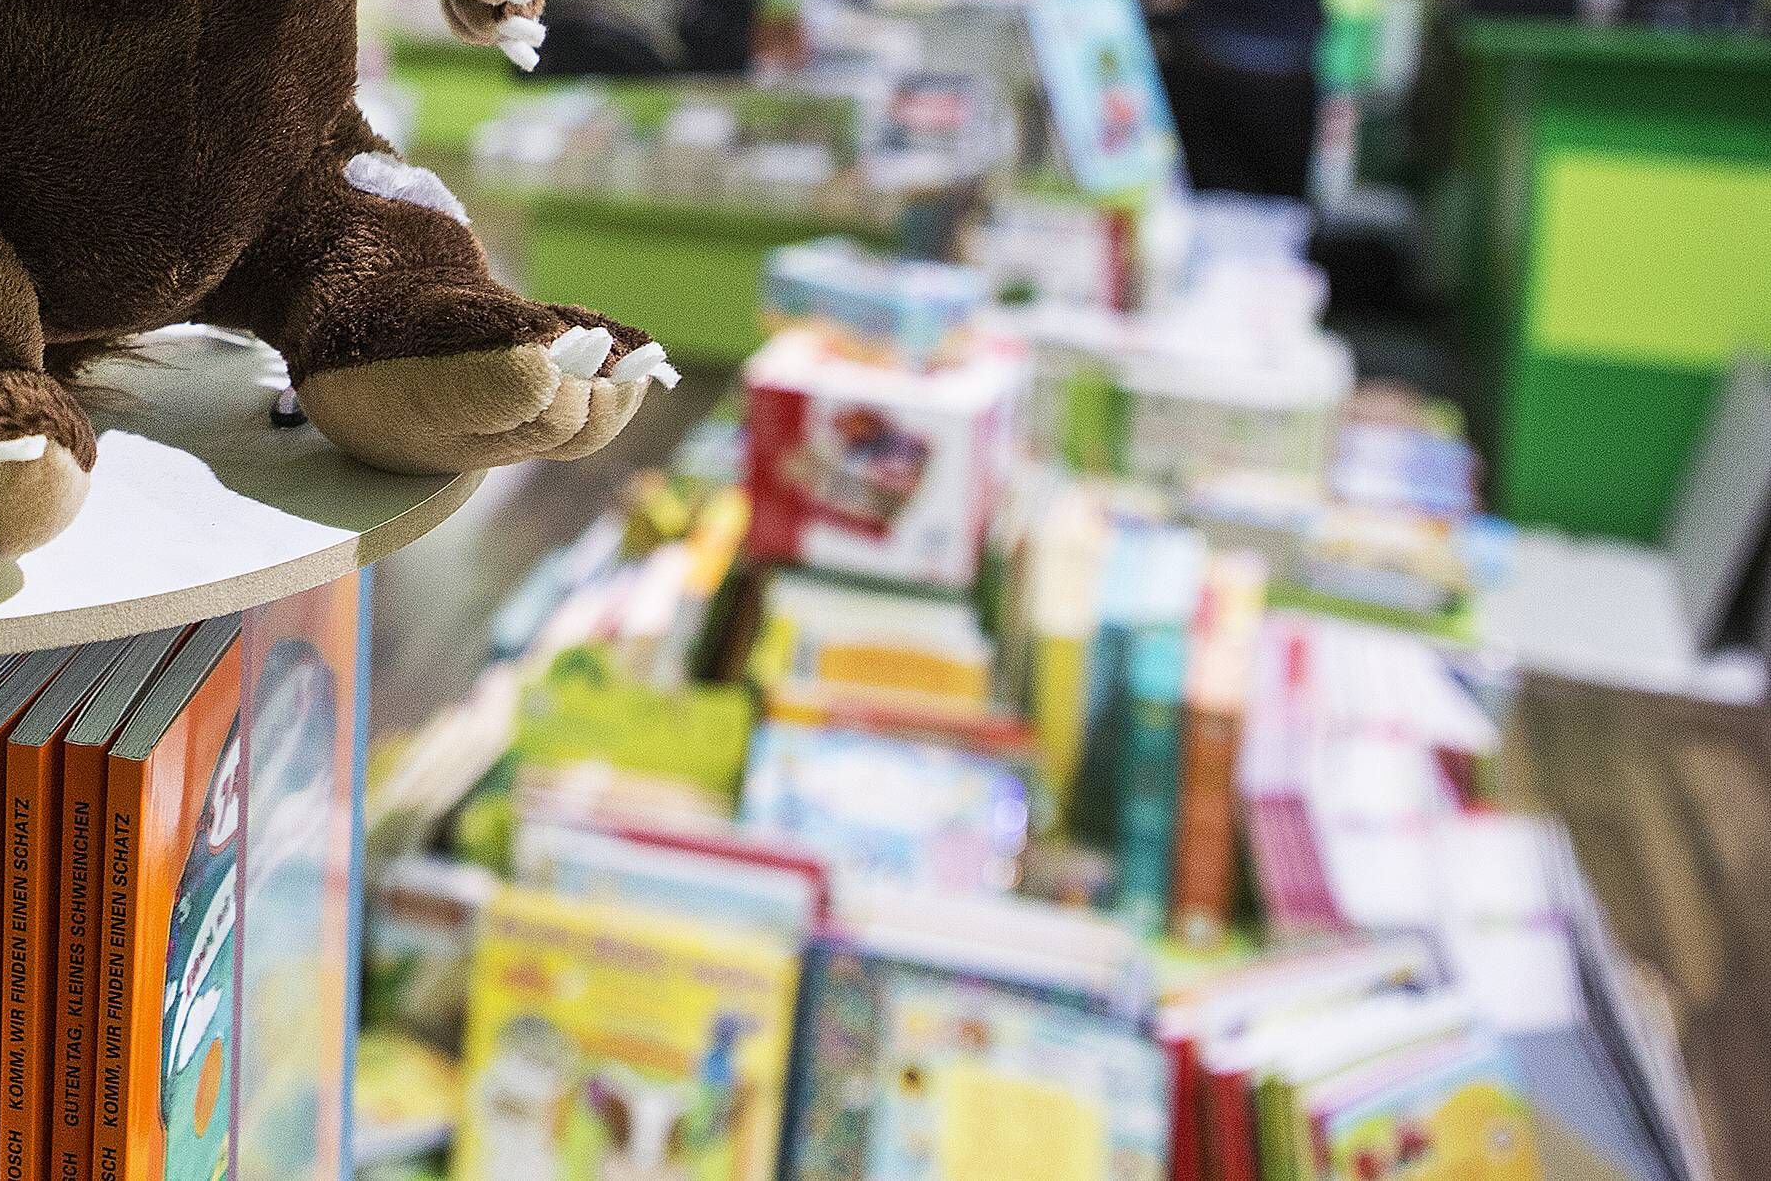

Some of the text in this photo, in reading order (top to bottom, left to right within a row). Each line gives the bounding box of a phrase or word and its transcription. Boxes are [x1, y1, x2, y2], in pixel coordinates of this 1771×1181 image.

[14, 795, 30, 870] SCHATZ
[113, 812, 130, 887] SCHATZ
[12, 876, 28, 932] EINEN
[110, 892, 127, 948] EINEN
[11, 936, 27, 1004] FINDEN
[65, 801, 90, 1127] GUTEN TAG, KLEINES SCHWEINCHEN
[108, 953, 125, 1020] FINDEN
[10, 1008, 25, 1042] WIR
[106, 1025, 122, 1059] WIR
[8, 1048, 25, 1111] KOMM,
[103, 1065, 122, 1127] KOMM,
